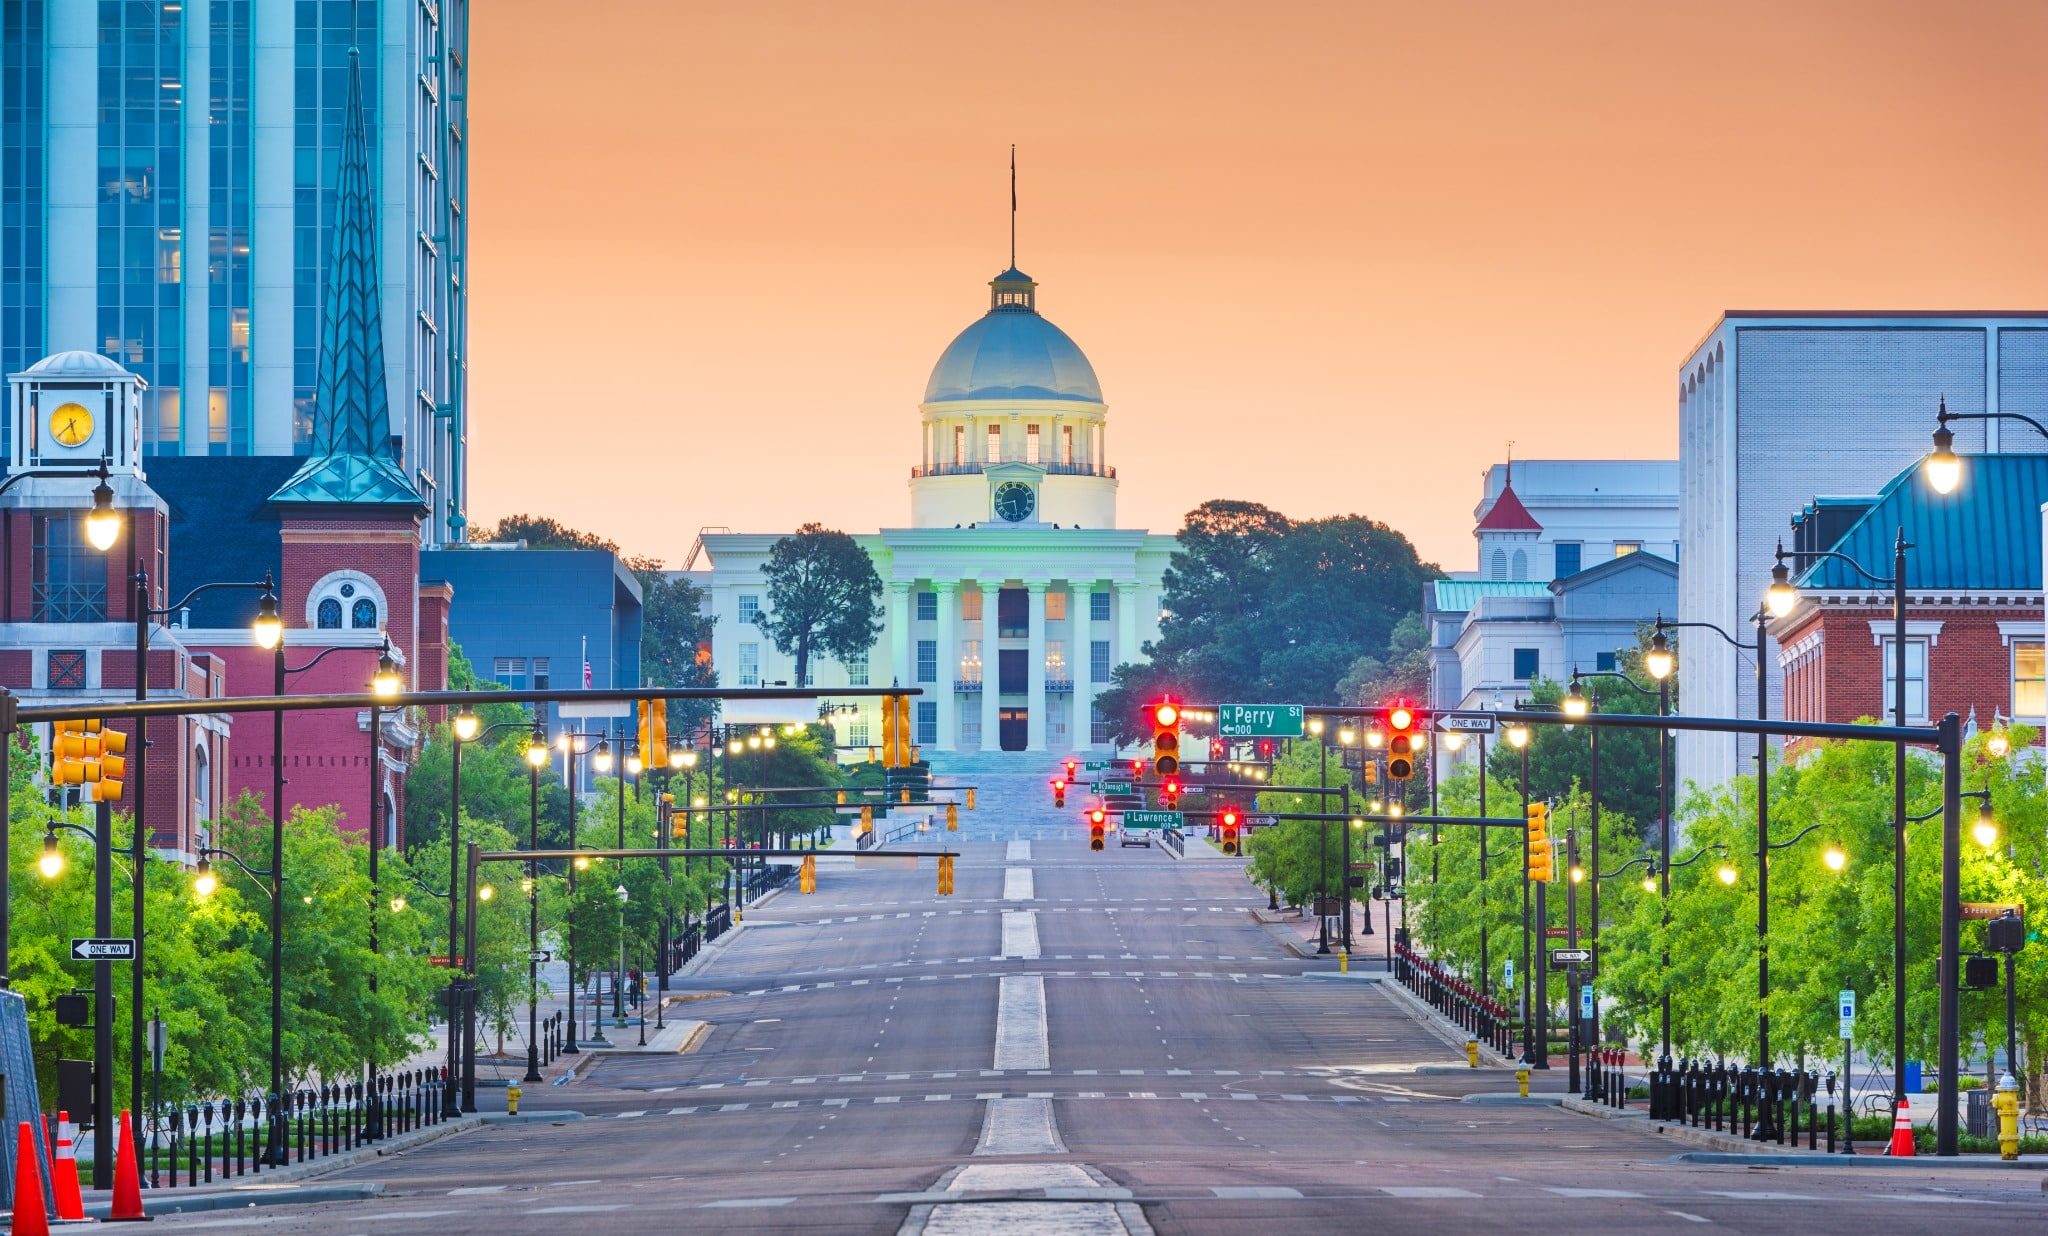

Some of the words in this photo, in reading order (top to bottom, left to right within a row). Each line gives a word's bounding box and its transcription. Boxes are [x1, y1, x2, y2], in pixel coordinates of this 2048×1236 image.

[1222, 709, 1230, 720] N
[1235, 706, 1275, 728] Perry
[1289, 706, 1300, 717] St
[1451, 719, 1468, 728] ONE
[1471, 719, 1488, 728] WAY
[1235, 724, 1252, 735] 000
[1133, 811, 1173, 822] Lawrence
[90, 945, 107, 954] ONE
[110, 945, 127, 954] WAY
